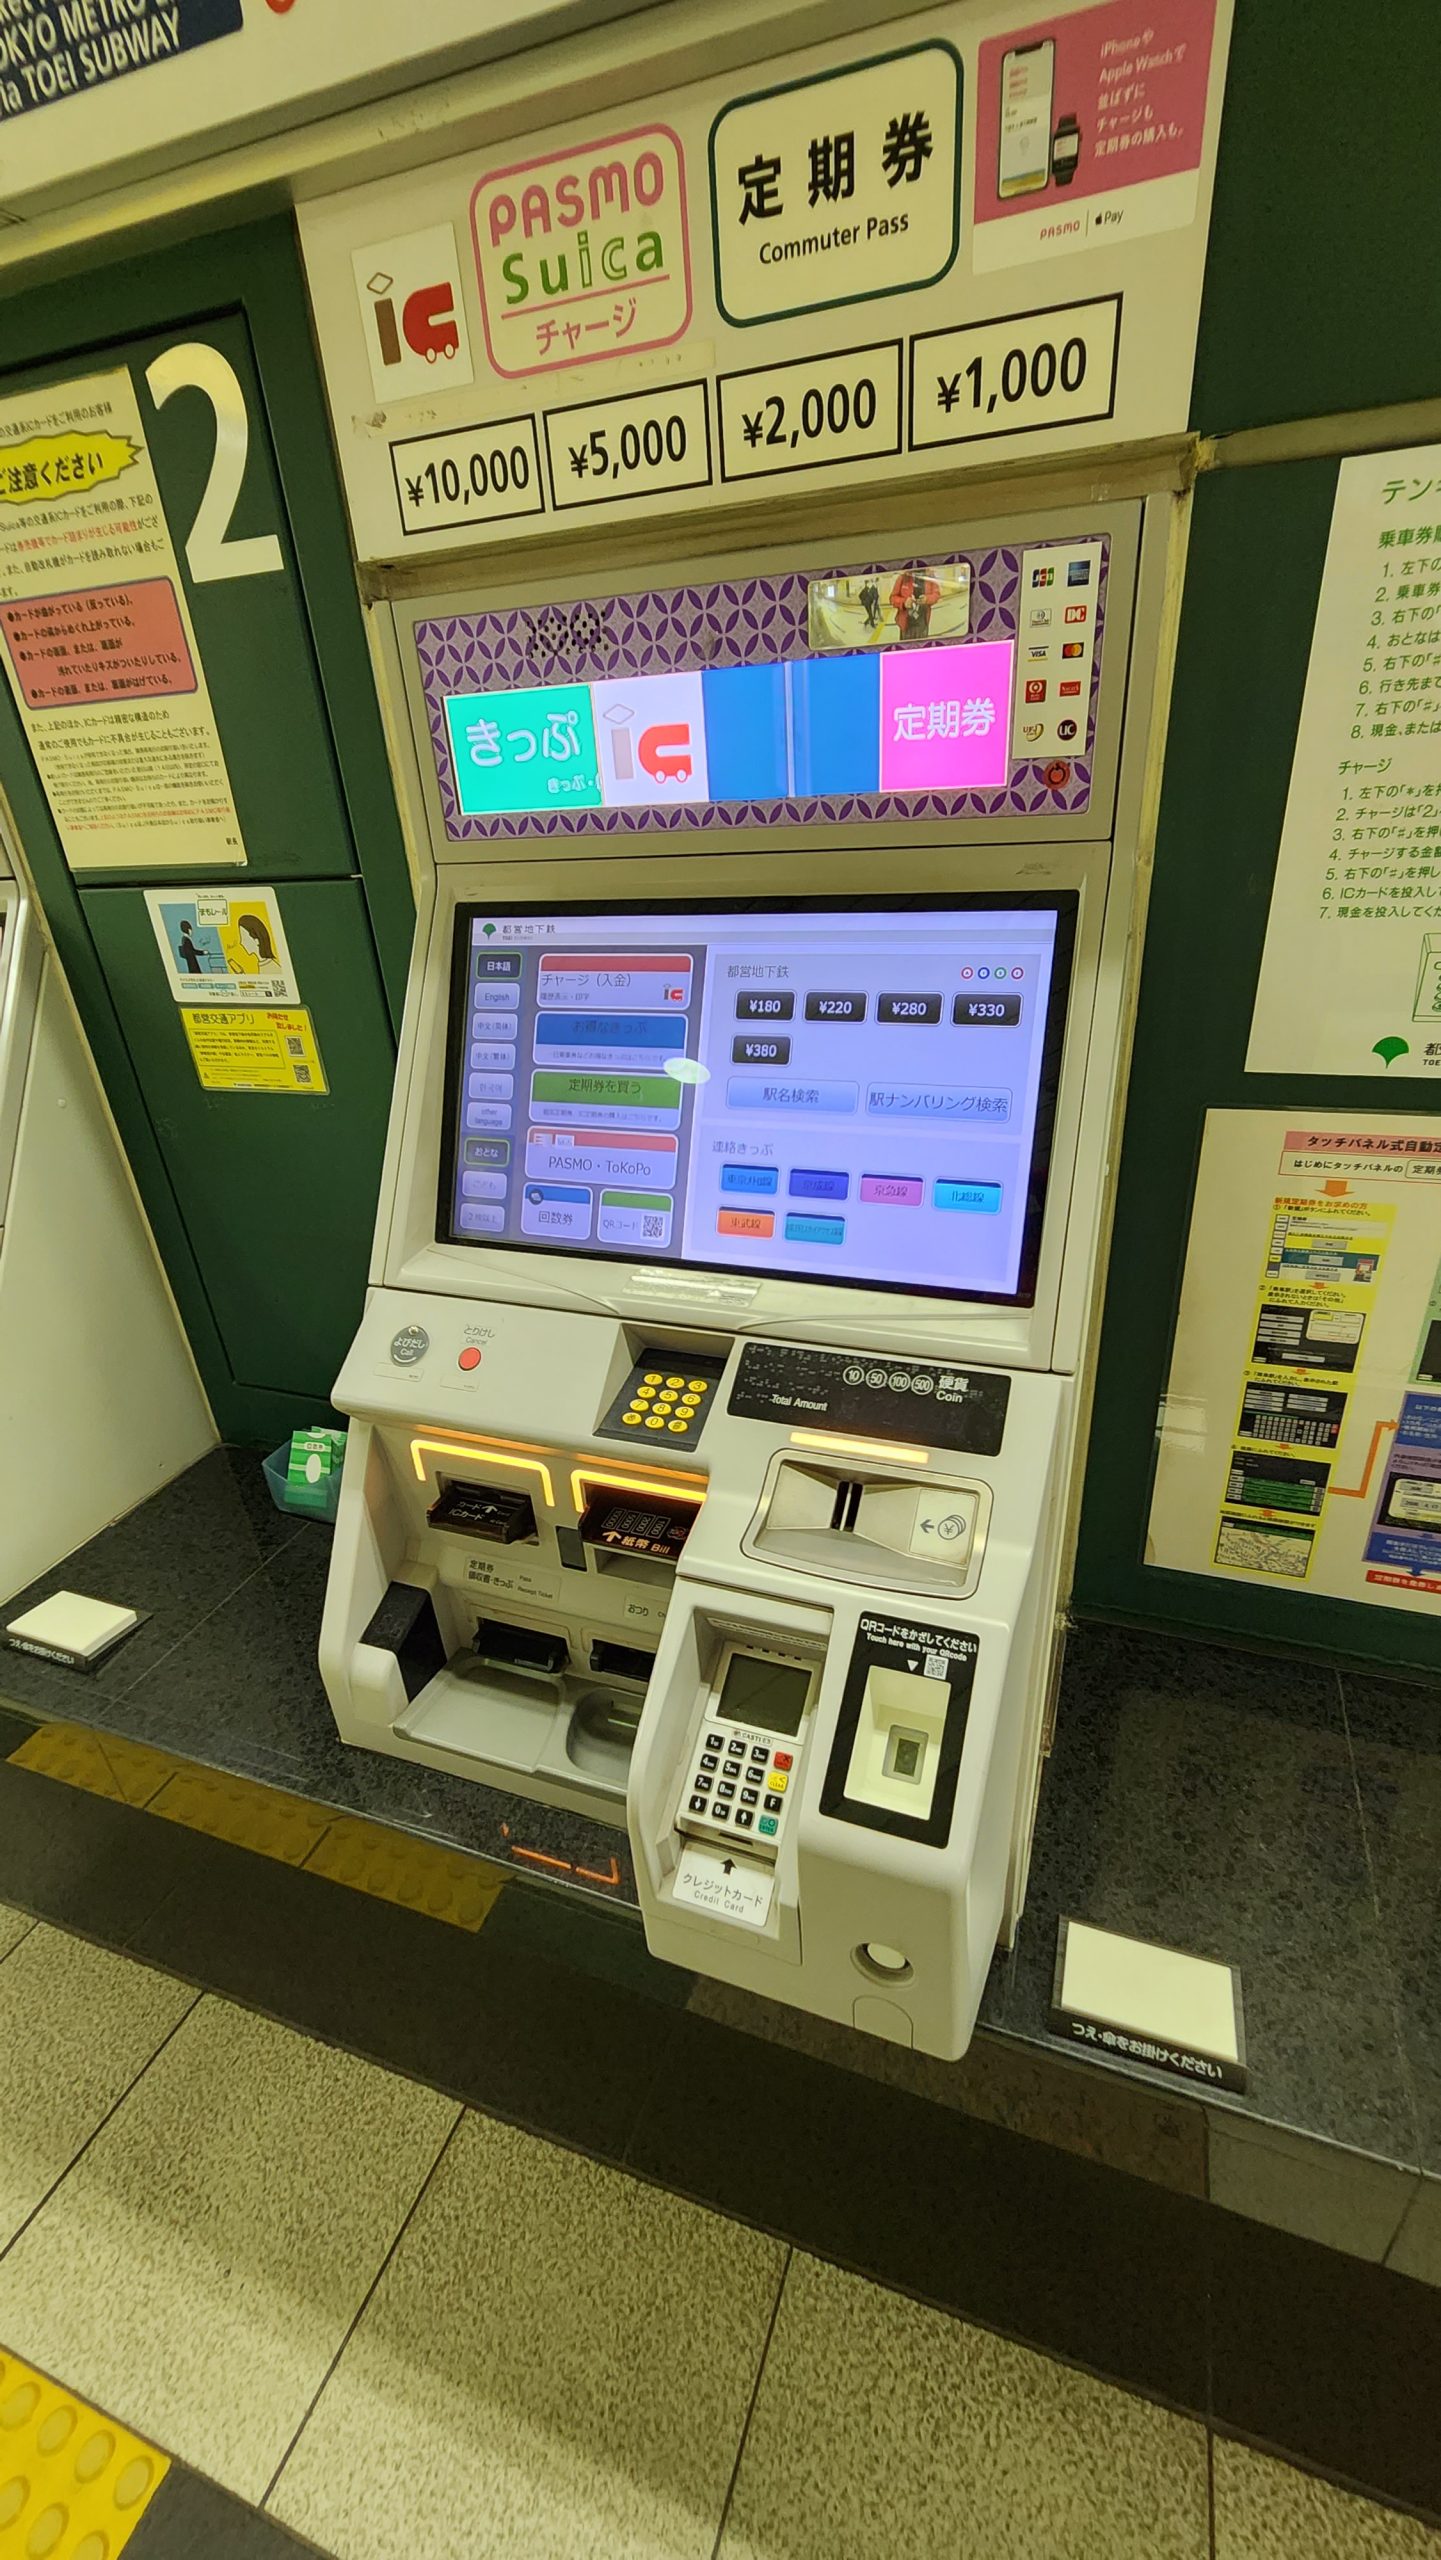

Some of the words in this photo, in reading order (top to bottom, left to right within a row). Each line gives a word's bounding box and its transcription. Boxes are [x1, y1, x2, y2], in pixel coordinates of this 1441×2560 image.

[0, 78, 25, 117] ia
[21, 50, 79, 103] TOEI
[78, 6, 181, 84] SUBWAY
[1099, 59, 1133, 84] Apple
[736, 110, 934, 226] 定期券
[488, 150, 666, 247] PASMO
[1039, 219, 1081, 241] PASMO
[1104, 209, 1124, 225] Pay
[758, 223, 861, 266] Commuter
[865, 210, 910, 242] Pass
[500, 229, 666, 305] Suica
[533, 297, 639, 356] チャージ
[936, 336, 1087, 415] ¥1,000
[740, 378, 877, 451] ¥2,000
[566, 414, 688, 480] ¥5,000
[143, 342, 286, 583] 2
[405, 444, 531, 508] ¥10,000
[1383, 479, 1441, 505] テン
[1030, 650, 1046, 658] VISA
[892, 696, 996, 742] 定期券
[465, 709, 582, 768] きっぷ
[1338, 757, 1393, 776] チャージ
[1355, 804, 1441, 820] チャージは「2」
[502, 924, 556, 934] 都営地下鉄
[486, 961, 512, 972] 日本語
[727, 964, 790, 979] 都営地下鉄
[484, 993, 510, 1002] English
[749, 999, 782, 1014] ¥180
[818, 1000, 853, 1015] ¥220
[891, 1001, 927, 1017] ¥280
[967, 1002, 1005, 1018] ¥330
[745, 1043, 778, 1058] ¥380
[567, 1078, 642, 1095] 定期券を買う
[762, 1086, 820, 1104] 駅名検索
[869, 1091, 1009, 1114] 駅ナンバリング検索
[475, 1147, 500, 1158] おとな
[712, 1140, 774, 1157] 連絡きっぷ
[538, 1210, 574, 1226] 回数券
[463, 1326, 496, 1338] とりけし
[938, 1374, 970, 1392] 硬貨
[771, 1393, 793, 1406] Total
[793, 1397, 829, 1411] Amount
[935, 1390, 963, 1403] Coin
[621, 1535, 650, 1549] 紙幣
[650, 1543, 671, 1554] Bill
[469, 1559, 495, 1574] 定期券
[628, 1603, 650, 1618] おつり
[860, 1618, 977, 1654] QRコードをかざしてください
[866, 1632, 888, 1645] Touch
[888, 1636, 904, 1648] here
[905, 1641, 921, 1652] with
[921, 1645, 938, 1656] your
[939, 1647, 968, 1662] QRcode
[683, 1873, 763, 1907] クレジットカード
[694, 1889, 720, 1906] Credit
[723, 1900, 744, 1914] Card
[1071, 2021, 1224, 2080] つえ・傘をお掛けください
